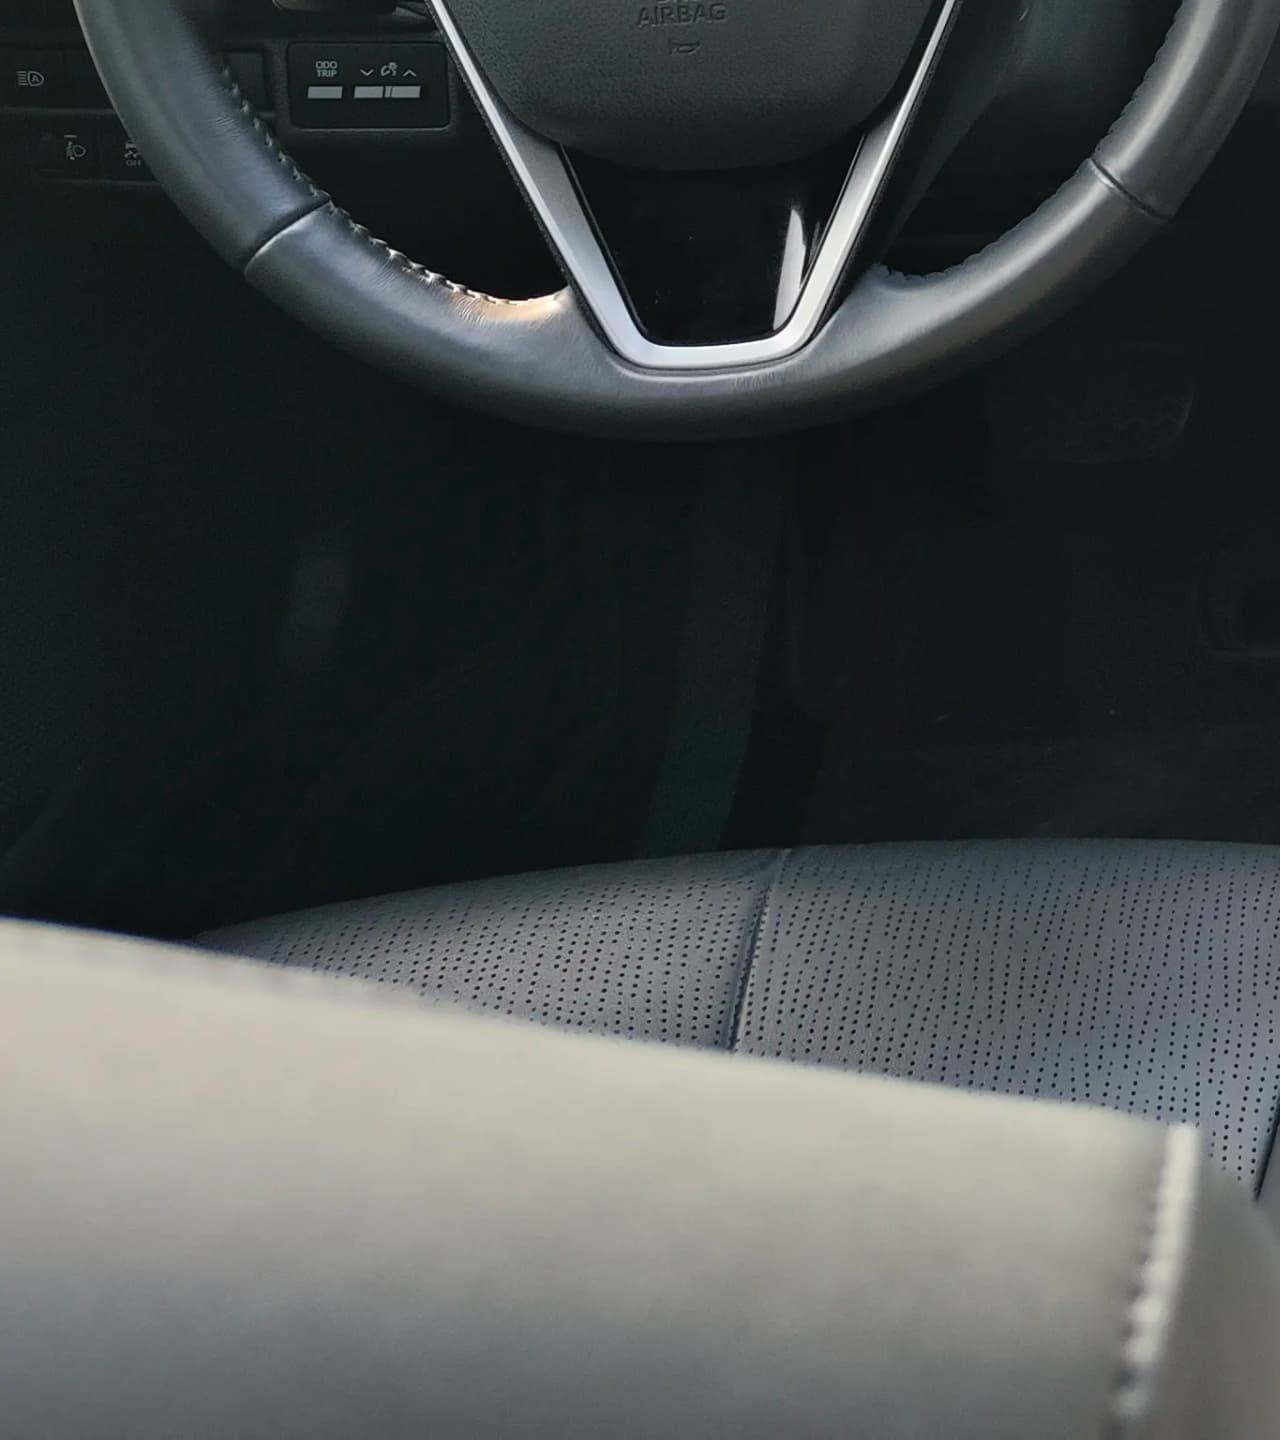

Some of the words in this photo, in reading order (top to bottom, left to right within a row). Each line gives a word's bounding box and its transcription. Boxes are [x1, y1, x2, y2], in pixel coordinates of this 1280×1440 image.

[636, 2, 729, 28] AIRBAG
[315, 60, 338, 69] ODO
[316, 69, 337, 78] TRIP
